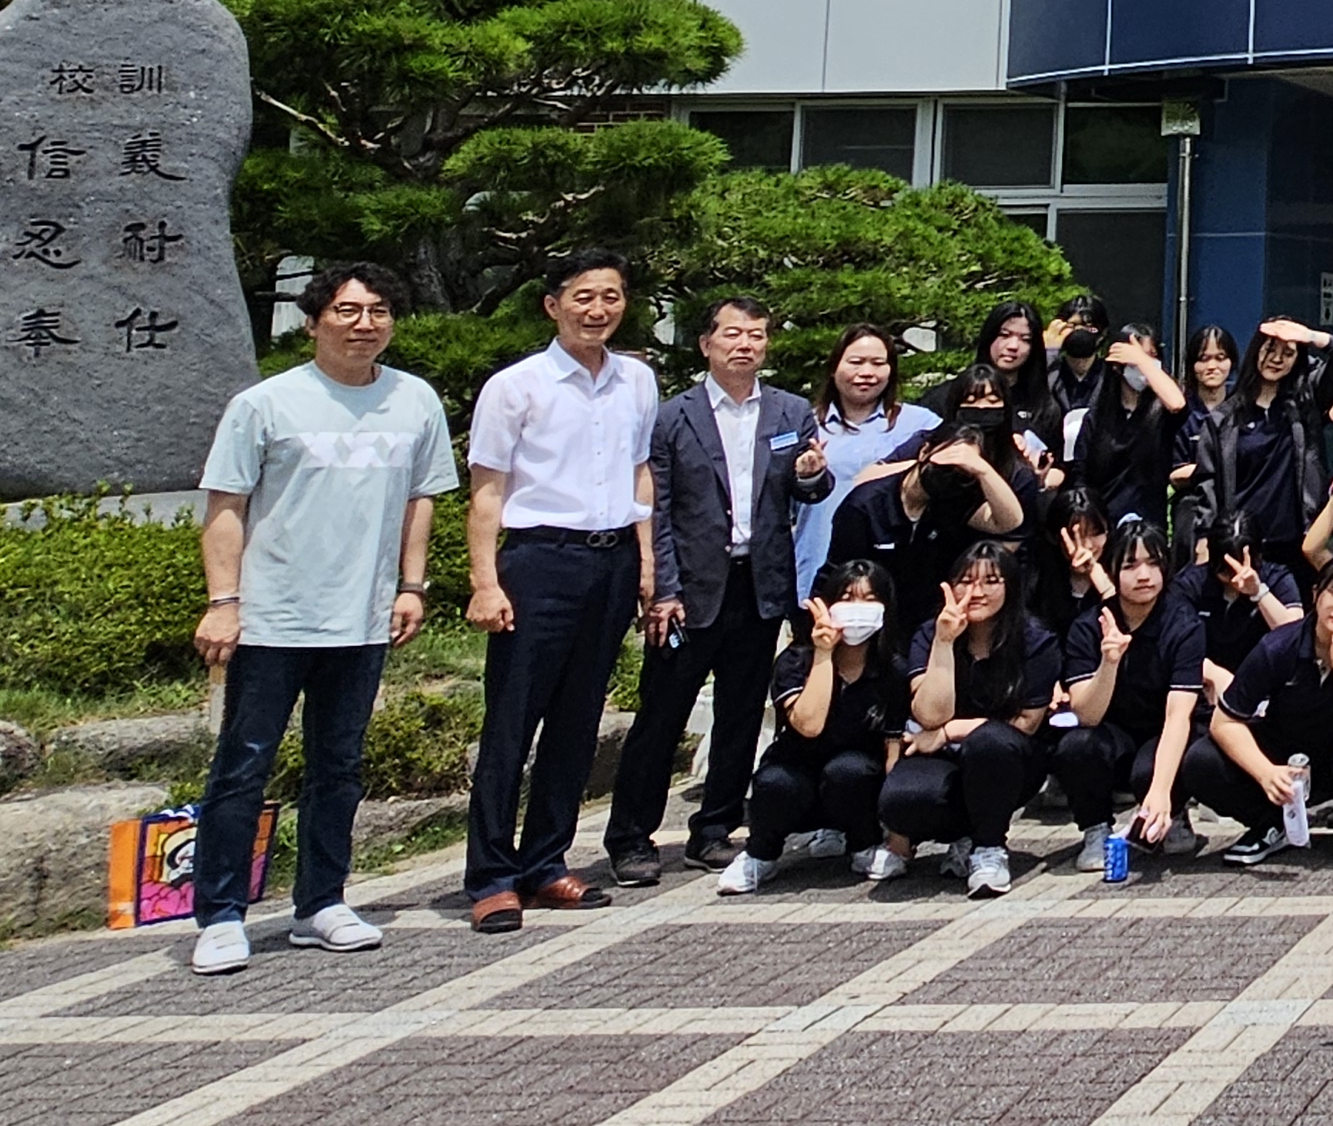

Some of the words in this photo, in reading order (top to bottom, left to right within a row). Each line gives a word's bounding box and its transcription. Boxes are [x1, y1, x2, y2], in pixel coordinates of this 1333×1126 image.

[49, 63, 164, 96] 校訓
[17, 132, 191, 182] 信義
[12, 219, 185, 270] 忍耐
[7, 306, 179, 358] 奉仕
